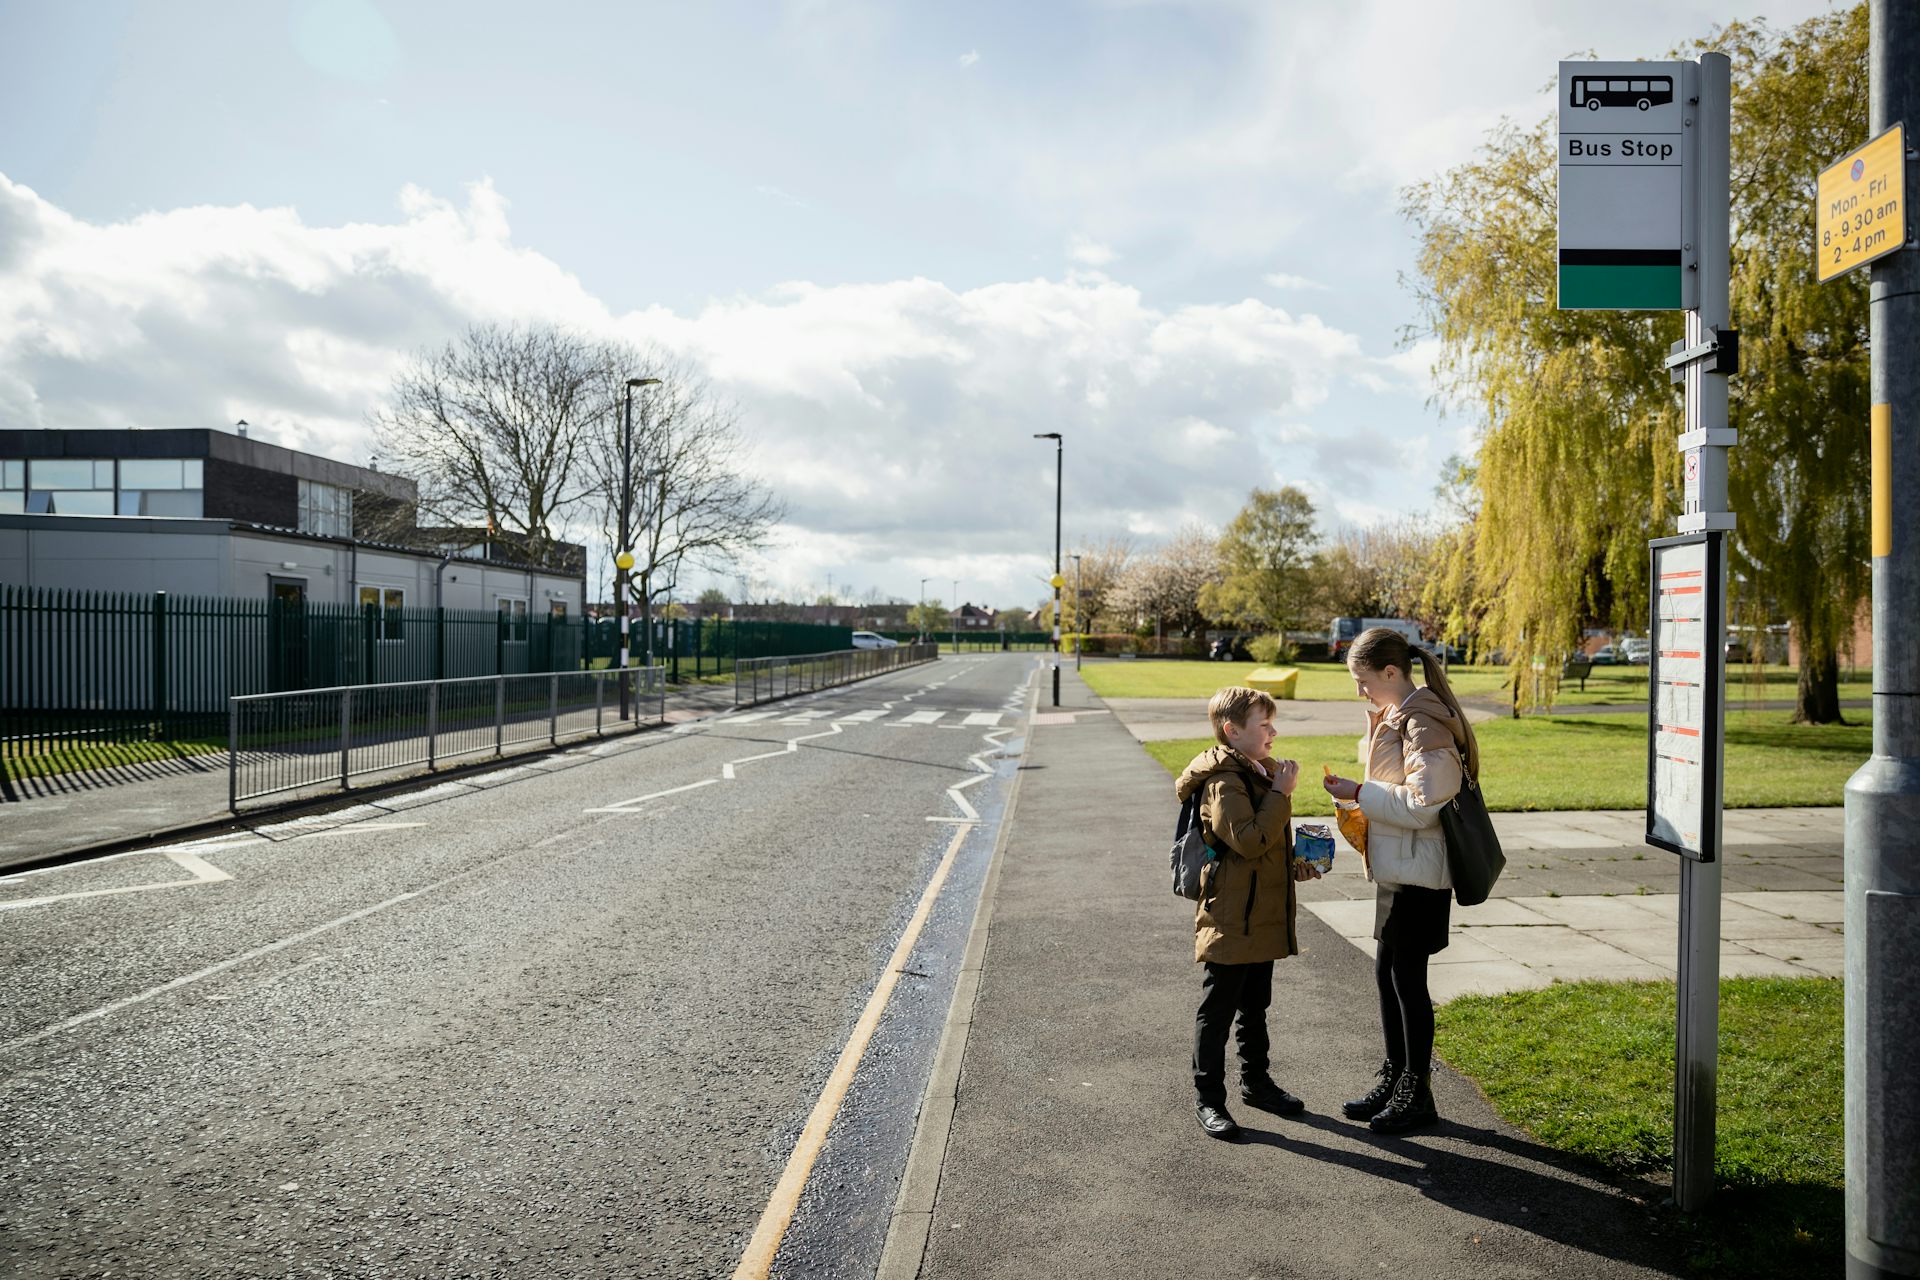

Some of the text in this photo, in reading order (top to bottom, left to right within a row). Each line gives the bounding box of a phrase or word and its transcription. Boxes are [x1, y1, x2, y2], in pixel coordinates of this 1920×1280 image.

[1569, 139, 1673, 160] Bus Stop
[1831, 195, 1858, 219] Mon
[1869, 174, 1887, 198] Fri
[1823, 230, 1831, 247] 8
[1842, 208, 1873, 238] 9.30
[1877, 200, 1897, 220] am
[1834, 247, 1841, 264] 2
[1852, 236, 1861, 253] 4
[1865, 229, 1885, 252] pm
